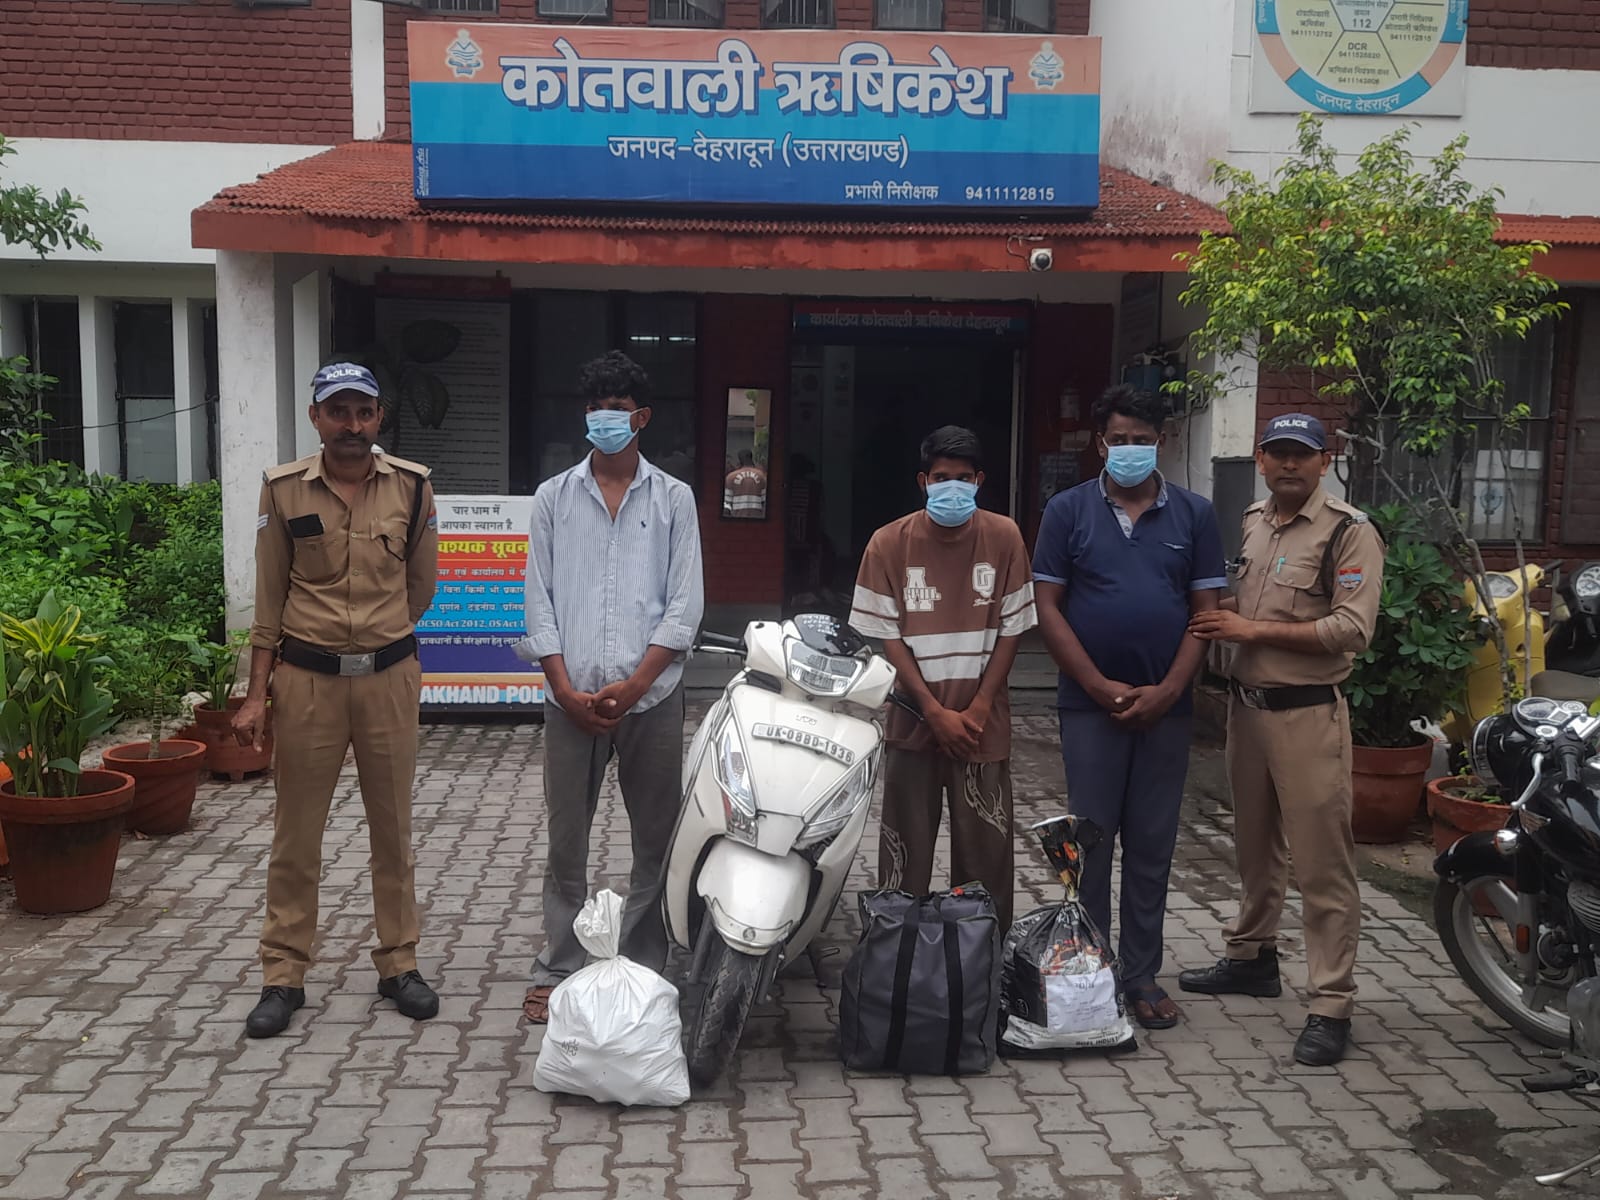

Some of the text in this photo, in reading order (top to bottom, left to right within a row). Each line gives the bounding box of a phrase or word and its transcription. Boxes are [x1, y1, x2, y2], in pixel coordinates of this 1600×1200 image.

[1352, 18, 1371, 28] 112
[1347, 42, 1368, 50] DCR
[499, 37, 1012, 117] कोतवाली ऋषिकेश
[1315, 90, 1400, 112] जनपद देहरादून
[782, 132, 909, 168] (उत्तराखण्ड)
[845, 181, 939, 200] प्रभारी निरीक्षक
[965, 186, 1055, 201] 9411112815
[326, 368, 363, 380] POLICE
[1273, 418, 1309, 429] POLICE
[451, 503, 501, 516] चार धाम में
[440, 518, 513, 530] आपका स्वागत है
[437, 541, 528, 559] वश्यक सूचन
[417, 619, 443, 628] OCSO
[446, 619, 459, 628] Act
[503, 619, 517, 628] Act
[420, 685, 546, 704] AKHAND POL
